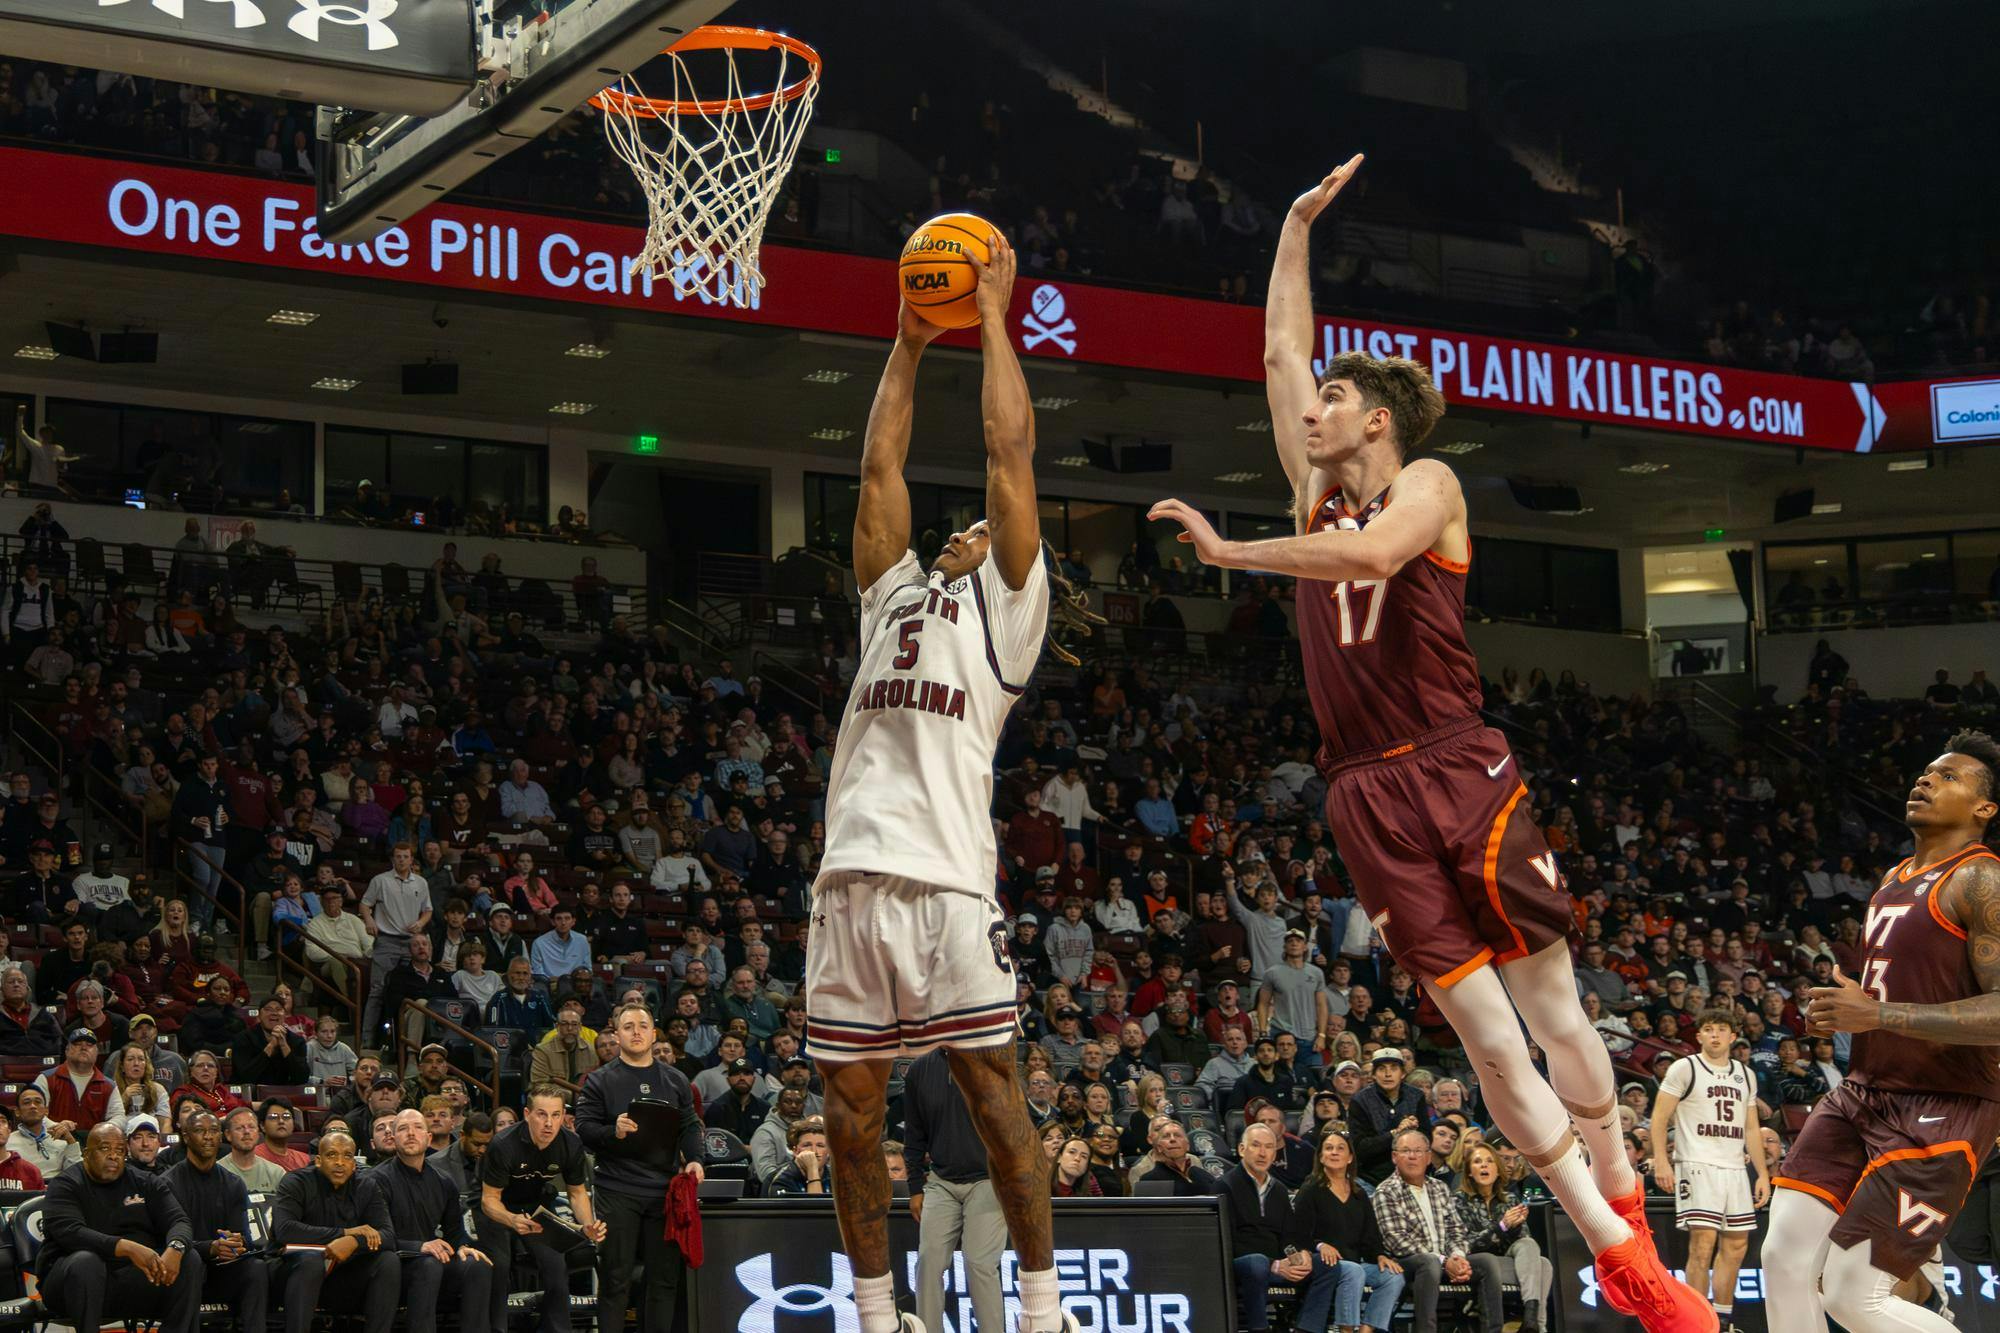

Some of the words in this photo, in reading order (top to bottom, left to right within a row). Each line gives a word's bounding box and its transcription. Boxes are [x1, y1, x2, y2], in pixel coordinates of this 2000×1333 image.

[107, 178, 240, 247] One
[430, 218, 519, 282] Pill
[539, 233, 653, 298] Can
[904, 271, 950, 291] NCAA
[1431, 338, 1554, 407] PLAIN
[1331, 578, 1390, 647] 17
[892, 620, 925, 670] 5
[855, 679, 965, 721] AROLINA
[90, 884, 124, 896] CAROLINA
[1864, 904, 1914, 949] VT
[1707, 1085, 1742, 1102] SOUTH
[1714, 1099, 1735, 1122] 15
[1697, 1123, 1744, 1140] CAROLINA
[1897, 1186, 1950, 1238] VT
